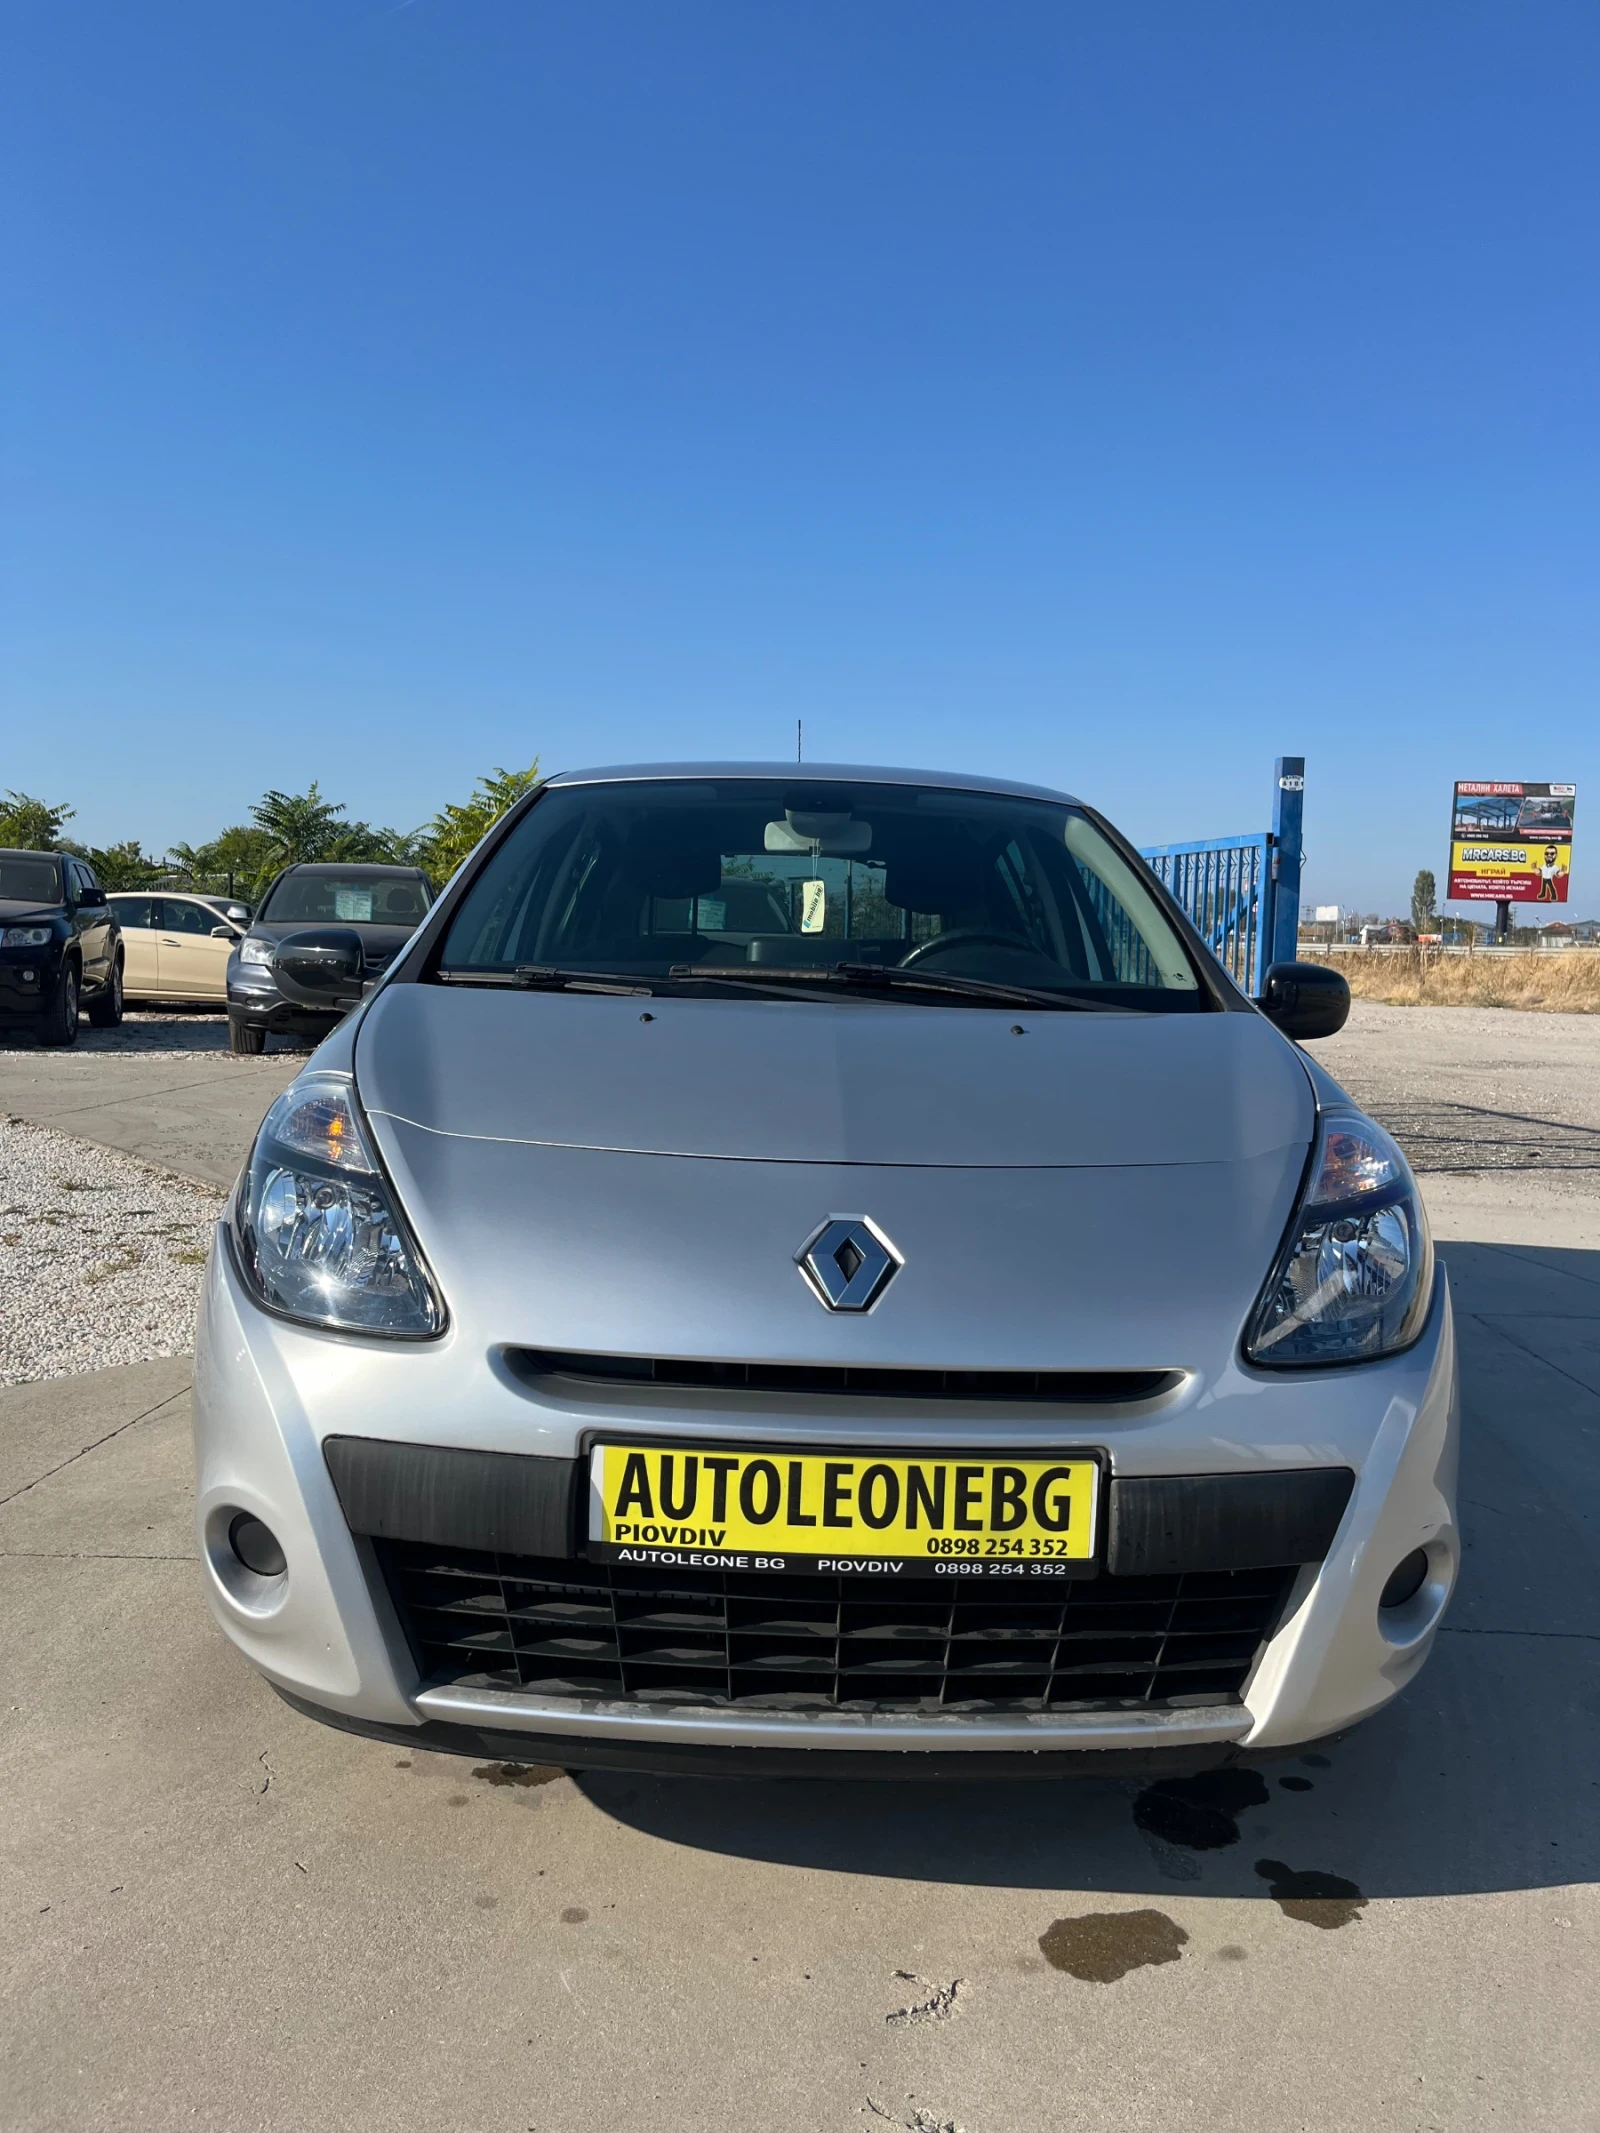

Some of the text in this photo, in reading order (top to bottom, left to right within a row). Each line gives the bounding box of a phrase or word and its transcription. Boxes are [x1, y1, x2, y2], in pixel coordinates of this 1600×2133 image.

[1457, 783, 1520, 793] МЕТАЛНИ ХАЛЕТА
[1462, 848, 1526, 863] MRCARS.BG
[614, 1452, 1072, 1533] AUTOLEONEBG
[615, 1524, 727, 1547] PIOVDIV
[927, 1537, 1068, 1557] 0898 254 352
[618, 1548, 1067, 1576] AUTOLEONE BG PIOVDIV 0898 254 352
